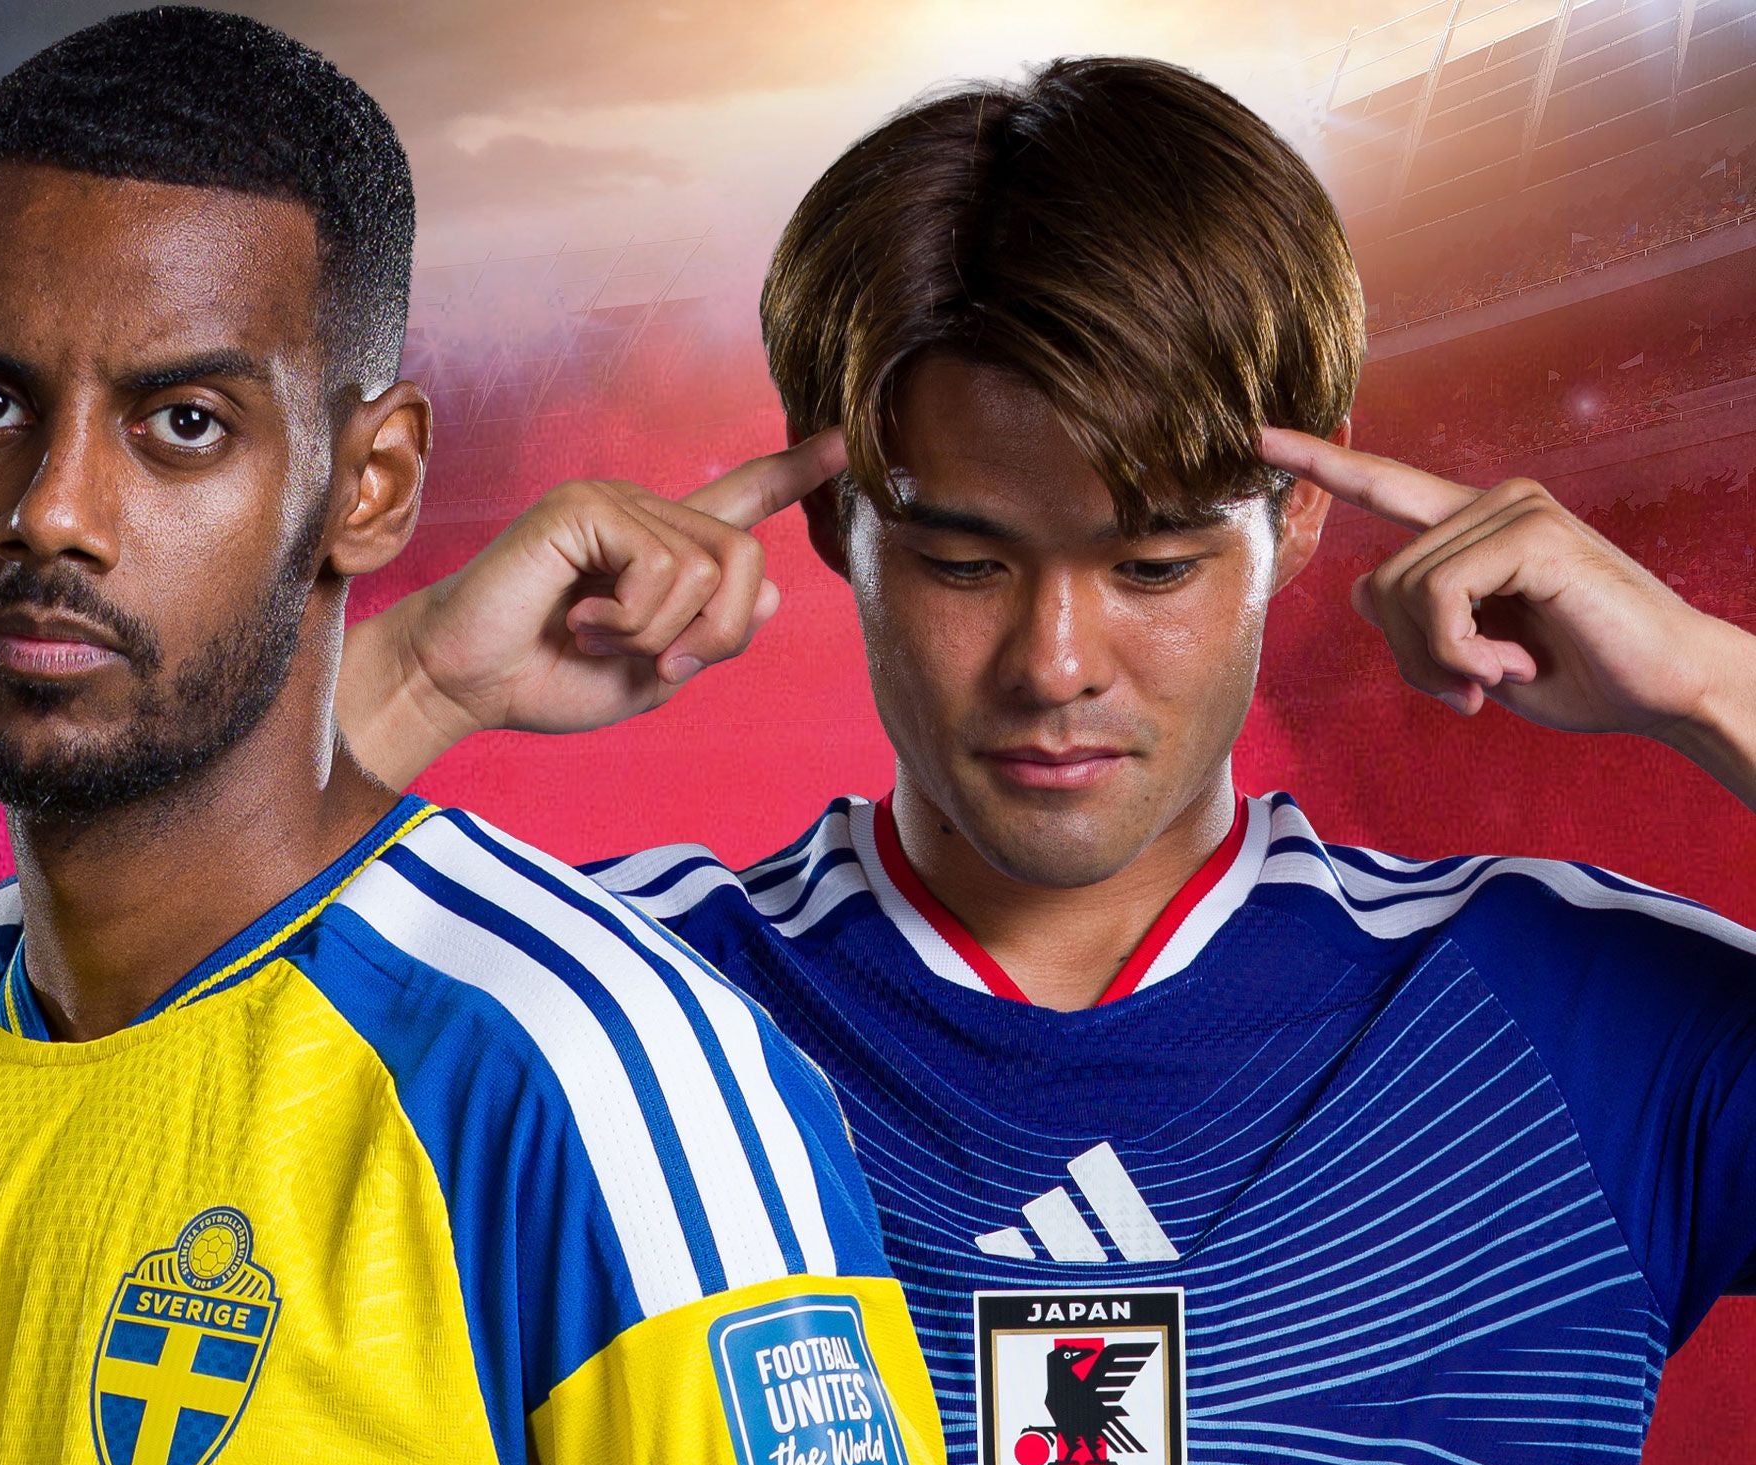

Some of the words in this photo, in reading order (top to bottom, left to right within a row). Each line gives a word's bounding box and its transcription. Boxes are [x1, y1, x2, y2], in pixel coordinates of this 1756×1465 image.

[180, 1229, 199, 1275] SVENSKA
[191, 1278, 212, 1289] 1904
[136, 1291, 251, 1330] SVERIGE
[1027, 1301, 1131, 1322] JAPAN
[755, 1336, 860, 1385] FOOTBALL
[764, 1373, 873, 1434] UNITES
